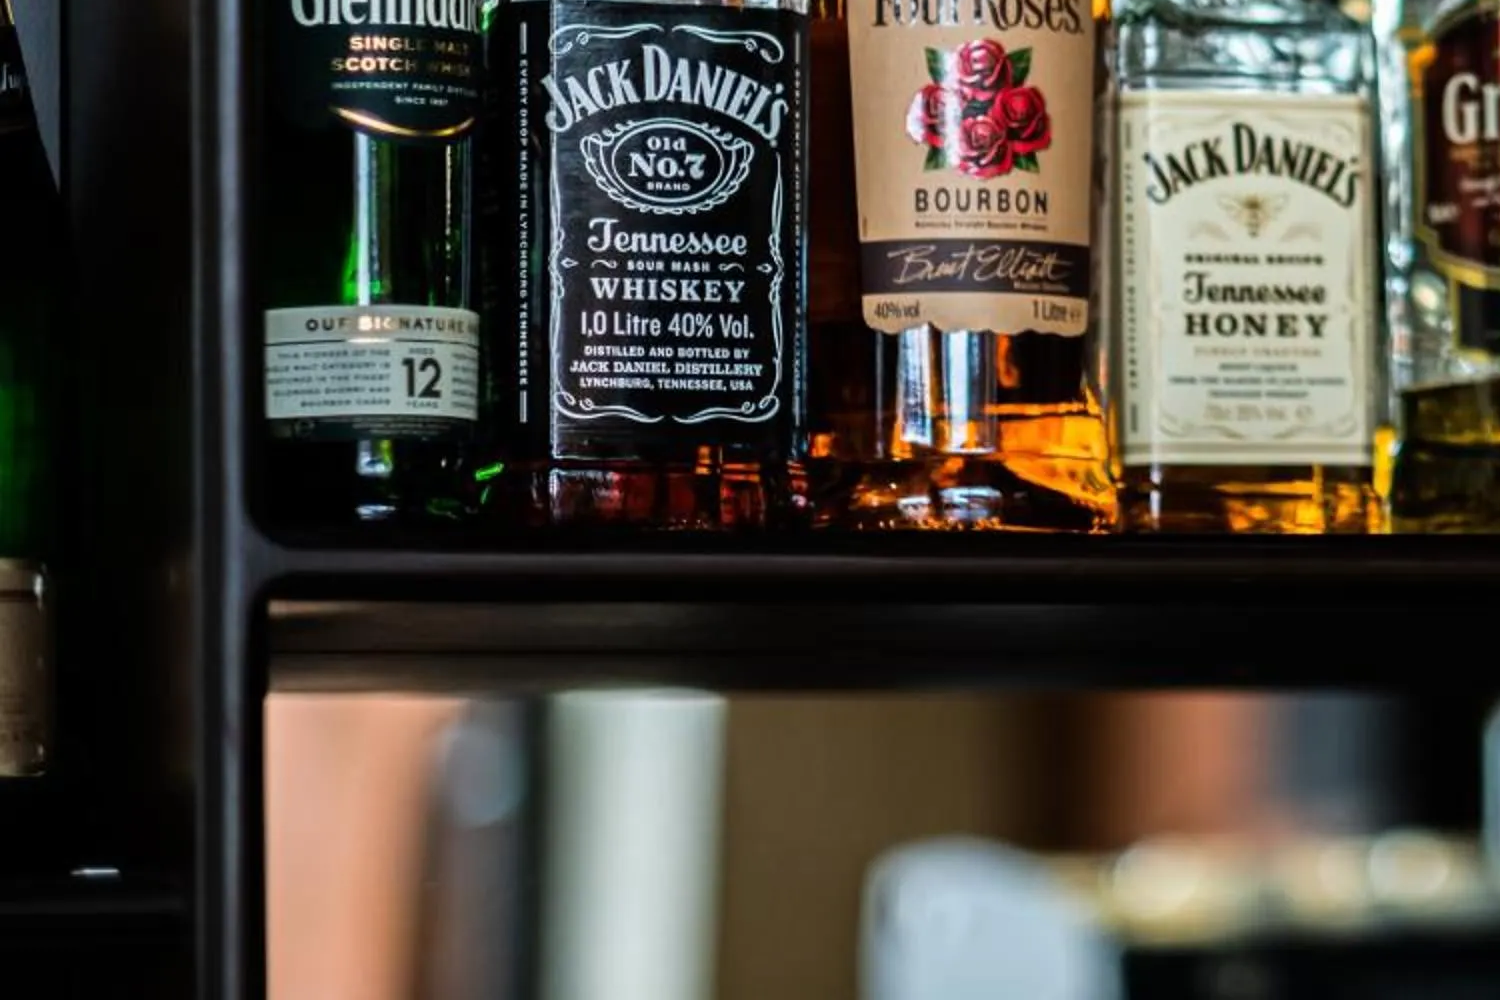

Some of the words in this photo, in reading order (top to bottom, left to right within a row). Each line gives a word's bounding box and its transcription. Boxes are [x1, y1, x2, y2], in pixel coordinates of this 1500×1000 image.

[349, 36, 426, 52] SINGLE
[331, 56, 417, 73] SCOTCH
[519, 58, 529, 105] EVERY
[540, 58, 640, 134] JACK
[642, 44, 789, 143] DANIEL'S
[393, 95, 427, 106] SINCE
[519, 108, 529, 147] DROP
[647, 135, 688, 152] Old
[519, 150, 529, 191] MADE
[628, 152, 706, 181] No.7
[1142, 137, 1230, 205] JACK
[1232, 123, 1362, 209] DANIEL'S
[647, 182, 691, 192] BRAND
[914, 188, 1049, 215] BOURBON
[587, 217, 748, 257] Tennessee
[627, 260, 665, 272] SOUR
[671, 261, 711, 273] MASH
[590, 277, 746, 304] WHISKEY
[1183, 272, 1327, 305] Tennessee
[613, 311, 661, 336] Litre
[668, 312, 713, 338] 40%
[719, 313, 755, 339] Vol.
[1184, 313, 1328, 339] HONEY
[519, 301, 529, 386] TENNESSEE
[584, 346, 645, 357] DISTILLED
[648, 346, 675, 358] AND
[677, 347, 731, 359] BOTTLED
[734, 348, 751, 359] BY
[401, 357, 442, 399] 12
[569, 362, 609, 374] JACK
[613, 362, 671, 375] DANIEL
[674, 363, 763, 377] DISTILLERY
[730, 379, 753, 392] USA
